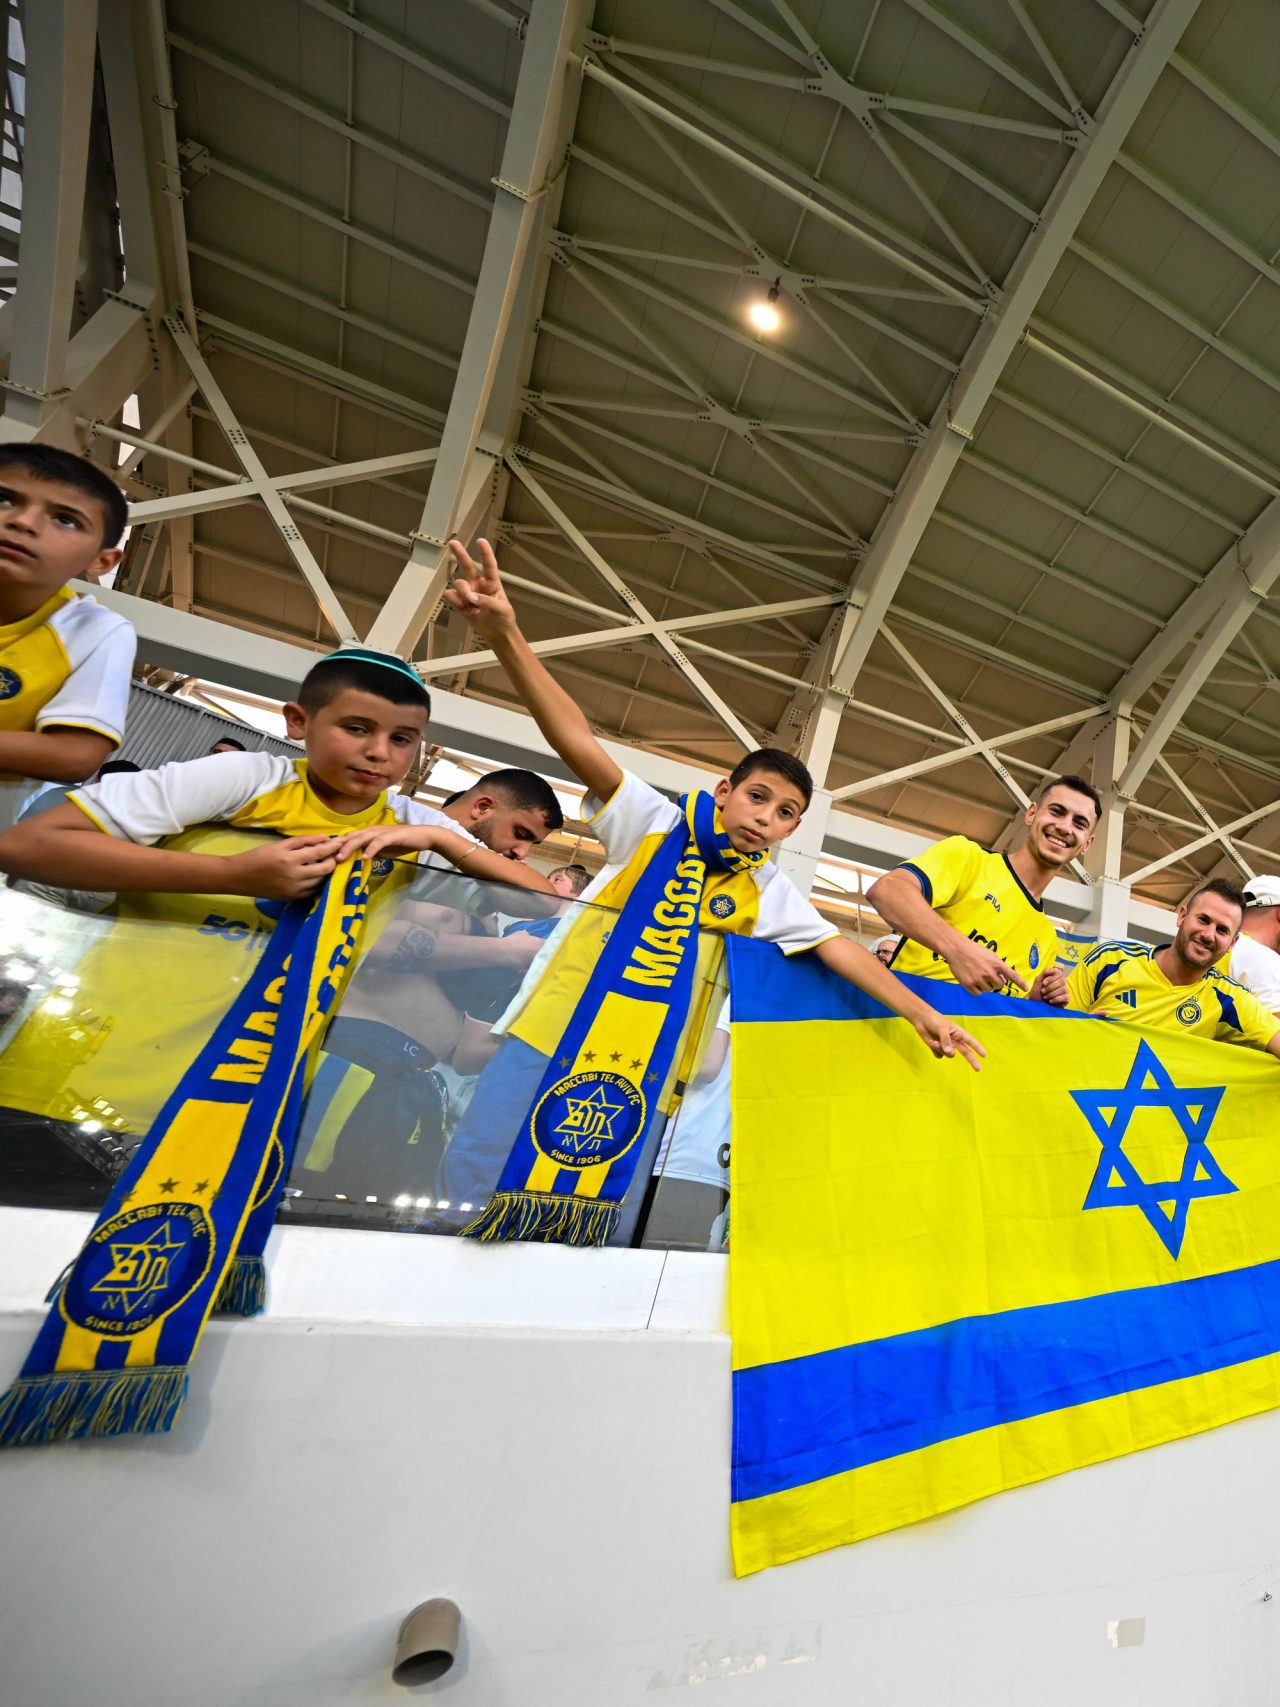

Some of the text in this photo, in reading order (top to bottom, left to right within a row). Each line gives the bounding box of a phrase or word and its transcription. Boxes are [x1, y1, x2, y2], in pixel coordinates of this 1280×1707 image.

[984, 892, 1001, 913] FILA
[197, 913, 251, 942] 5G
[600, 1073, 615, 1084] TEL
[614, 1078, 634, 1096] AVIV
[627, 1092, 641, 1106] FC
[550, 1149, 575, 1164] SINCE
[166, 1203, 187, 1216] TEL
[84, 1315, 123, 1332] SINCE
